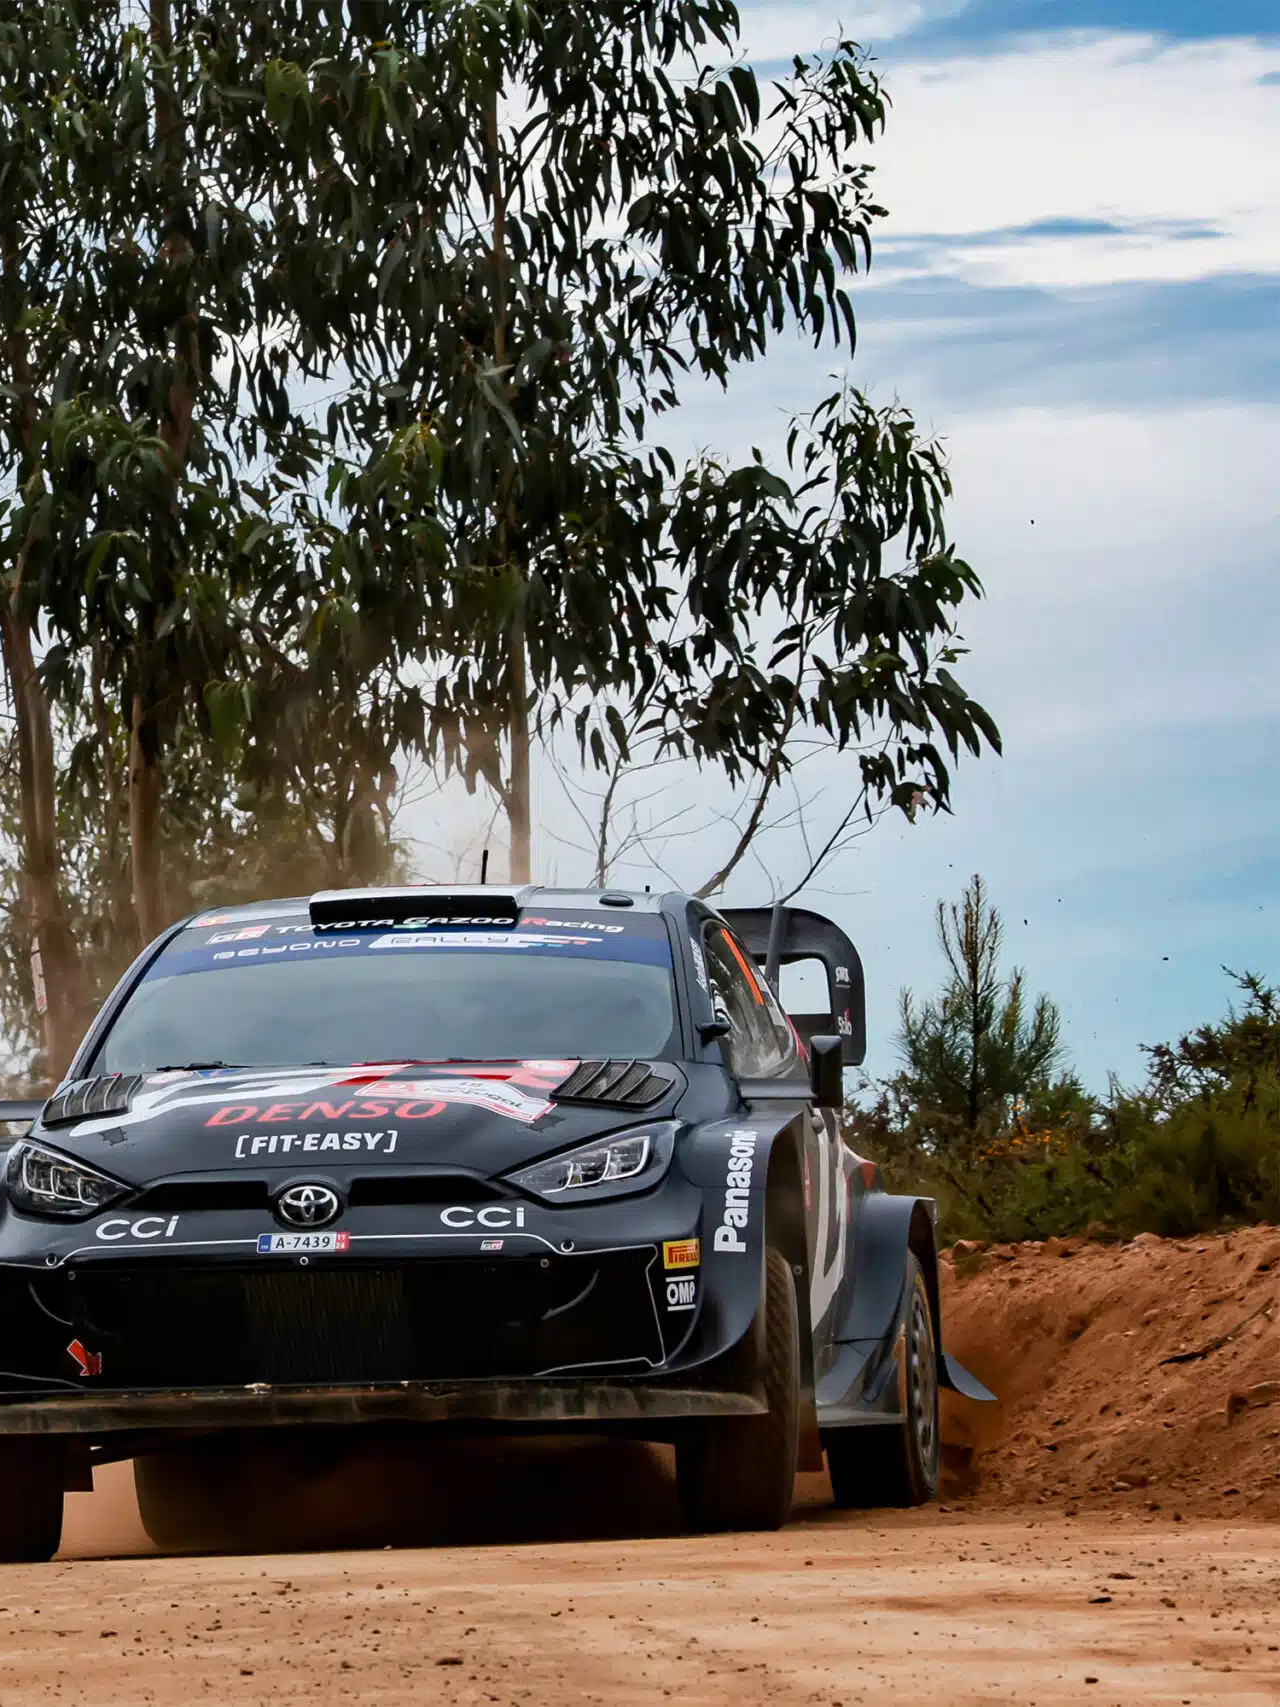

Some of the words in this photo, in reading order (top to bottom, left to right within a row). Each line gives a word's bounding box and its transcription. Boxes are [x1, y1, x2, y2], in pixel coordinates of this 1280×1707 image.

[276, 918, 394, 934] TOYOTA
[402, 917, 515, 925] GAZOO
[522, 917, 625, 933] Racing
[213, 938, 361, 960] BEYOND
[390, 936, 509, 944] RALLY
[204, 1100, 448, 1127] DENSO
[275, 1236, 331, 1249] A-7439
[666, 1281, 696, 1305] OMP
